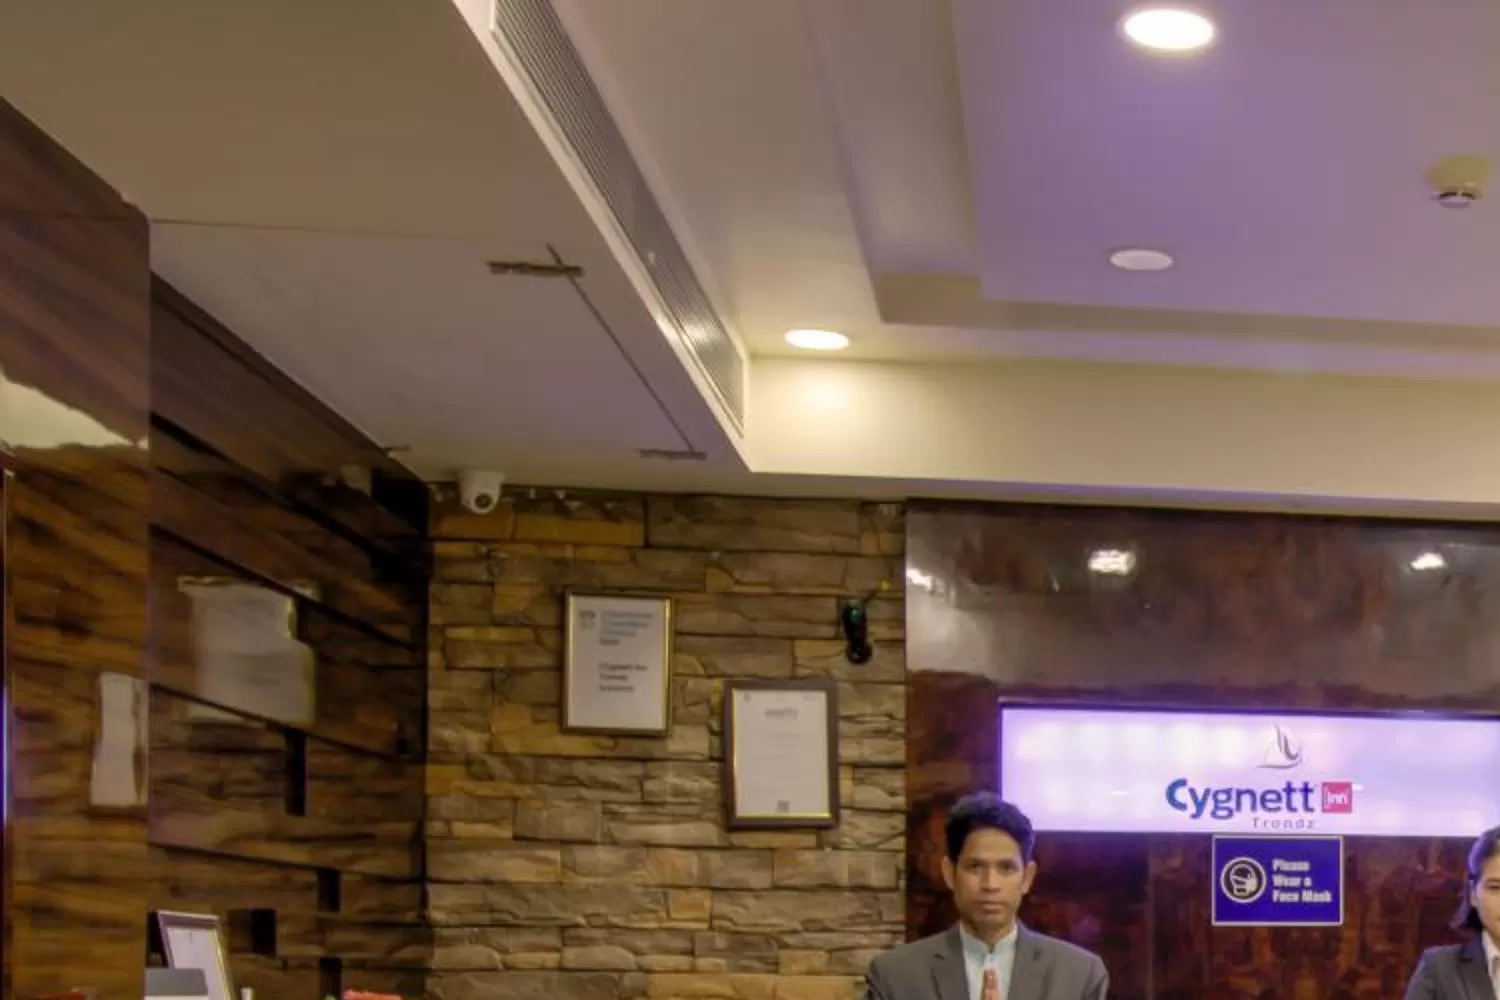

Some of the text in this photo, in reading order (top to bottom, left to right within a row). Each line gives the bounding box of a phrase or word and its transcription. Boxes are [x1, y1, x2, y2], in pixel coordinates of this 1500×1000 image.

[1166, 777, 1315, 820] Cygnett
[1271, 858, 1311, 872] Please
[1271, 874, 1312, 888] Wear a
[1271, 889, 1333, 904] Face Mask
